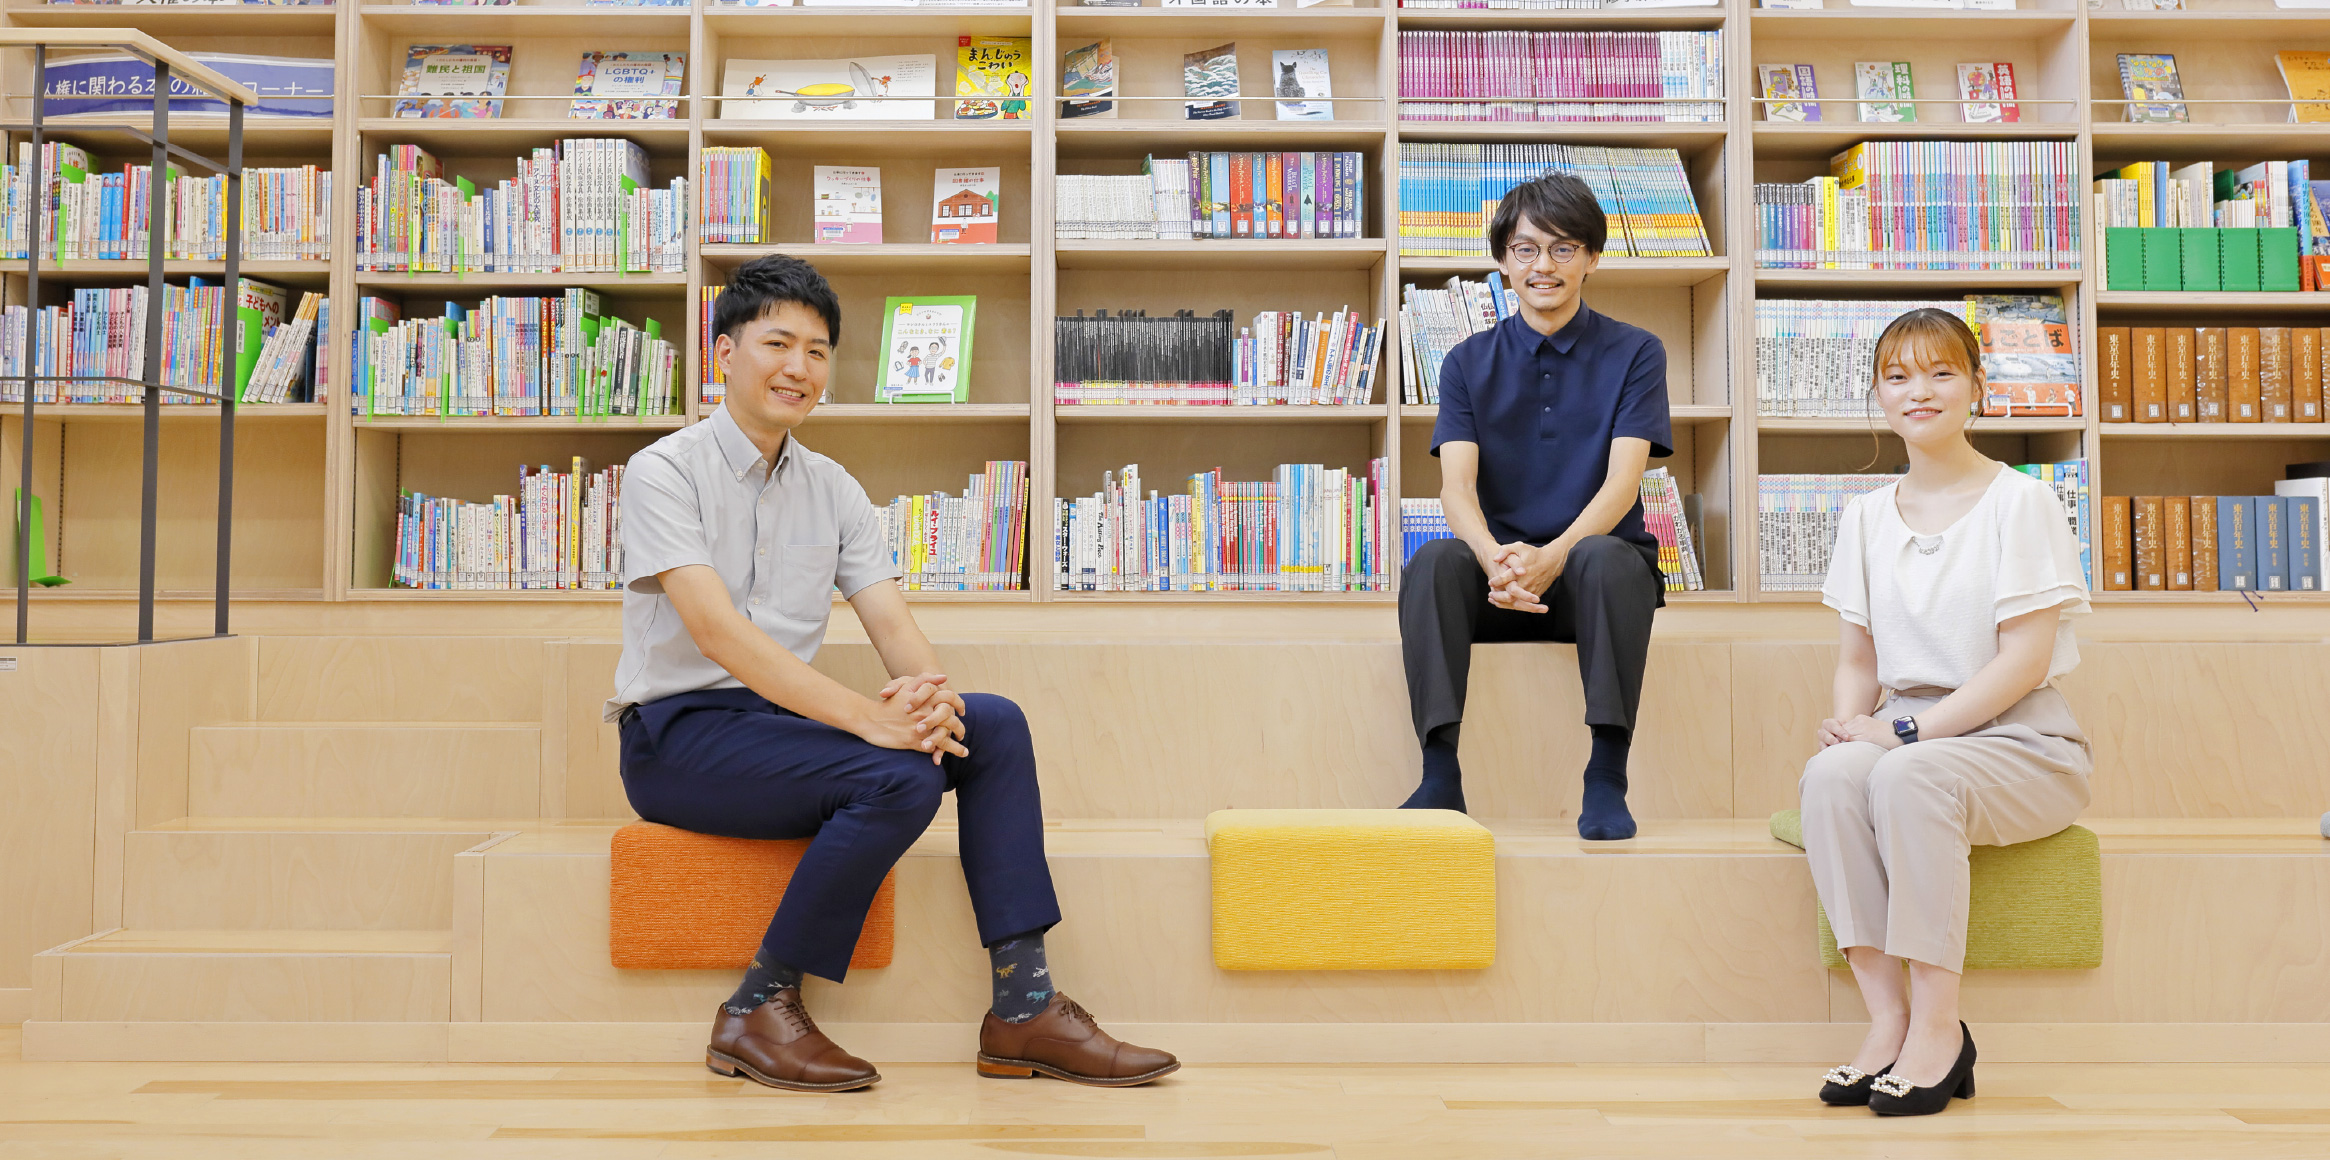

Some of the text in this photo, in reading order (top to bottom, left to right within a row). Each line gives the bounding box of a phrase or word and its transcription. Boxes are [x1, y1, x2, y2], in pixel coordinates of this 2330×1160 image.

[426, 65, 486, 74] 難民と祖国
[968, 48, 1022, 61] まんじゅう
[977, 61, 1013, 70] こわい
[613, 76, 645, 84] の権利
[246, 294, 279, 314] 子どもへの
[1980, 329, 2064, 348] しごとば
[2109, 334, 2120, 380] 東京百年史
[2146, 334, 2157, 380] 東京百年史
[2177, 334, 2188, 380] 東京百年史
[2207, 334, 2218, 380] 東京百年史
[2240, 334, 2250, 380] 東京百年史
[2271, 334, 2281, 380] 東京百年史
[2302, 334, 2313, 380] 東京百年史
[929, 510, 939, 556] ルイ・ブライユ
[2114, 503, 2124, 549] 東京百年史
[2147, 503, 2157, 549] 東京百年史
[2174, 503, 2185, 549] 東京百年史
[2201, 503, 2212, 549] 東京百年史
[2232, 503, 2244, 549] 東京百年史
[2268, 503, 2279, 549] 東京百年史
[2299, 503, 2310, 549] 東京百年史
